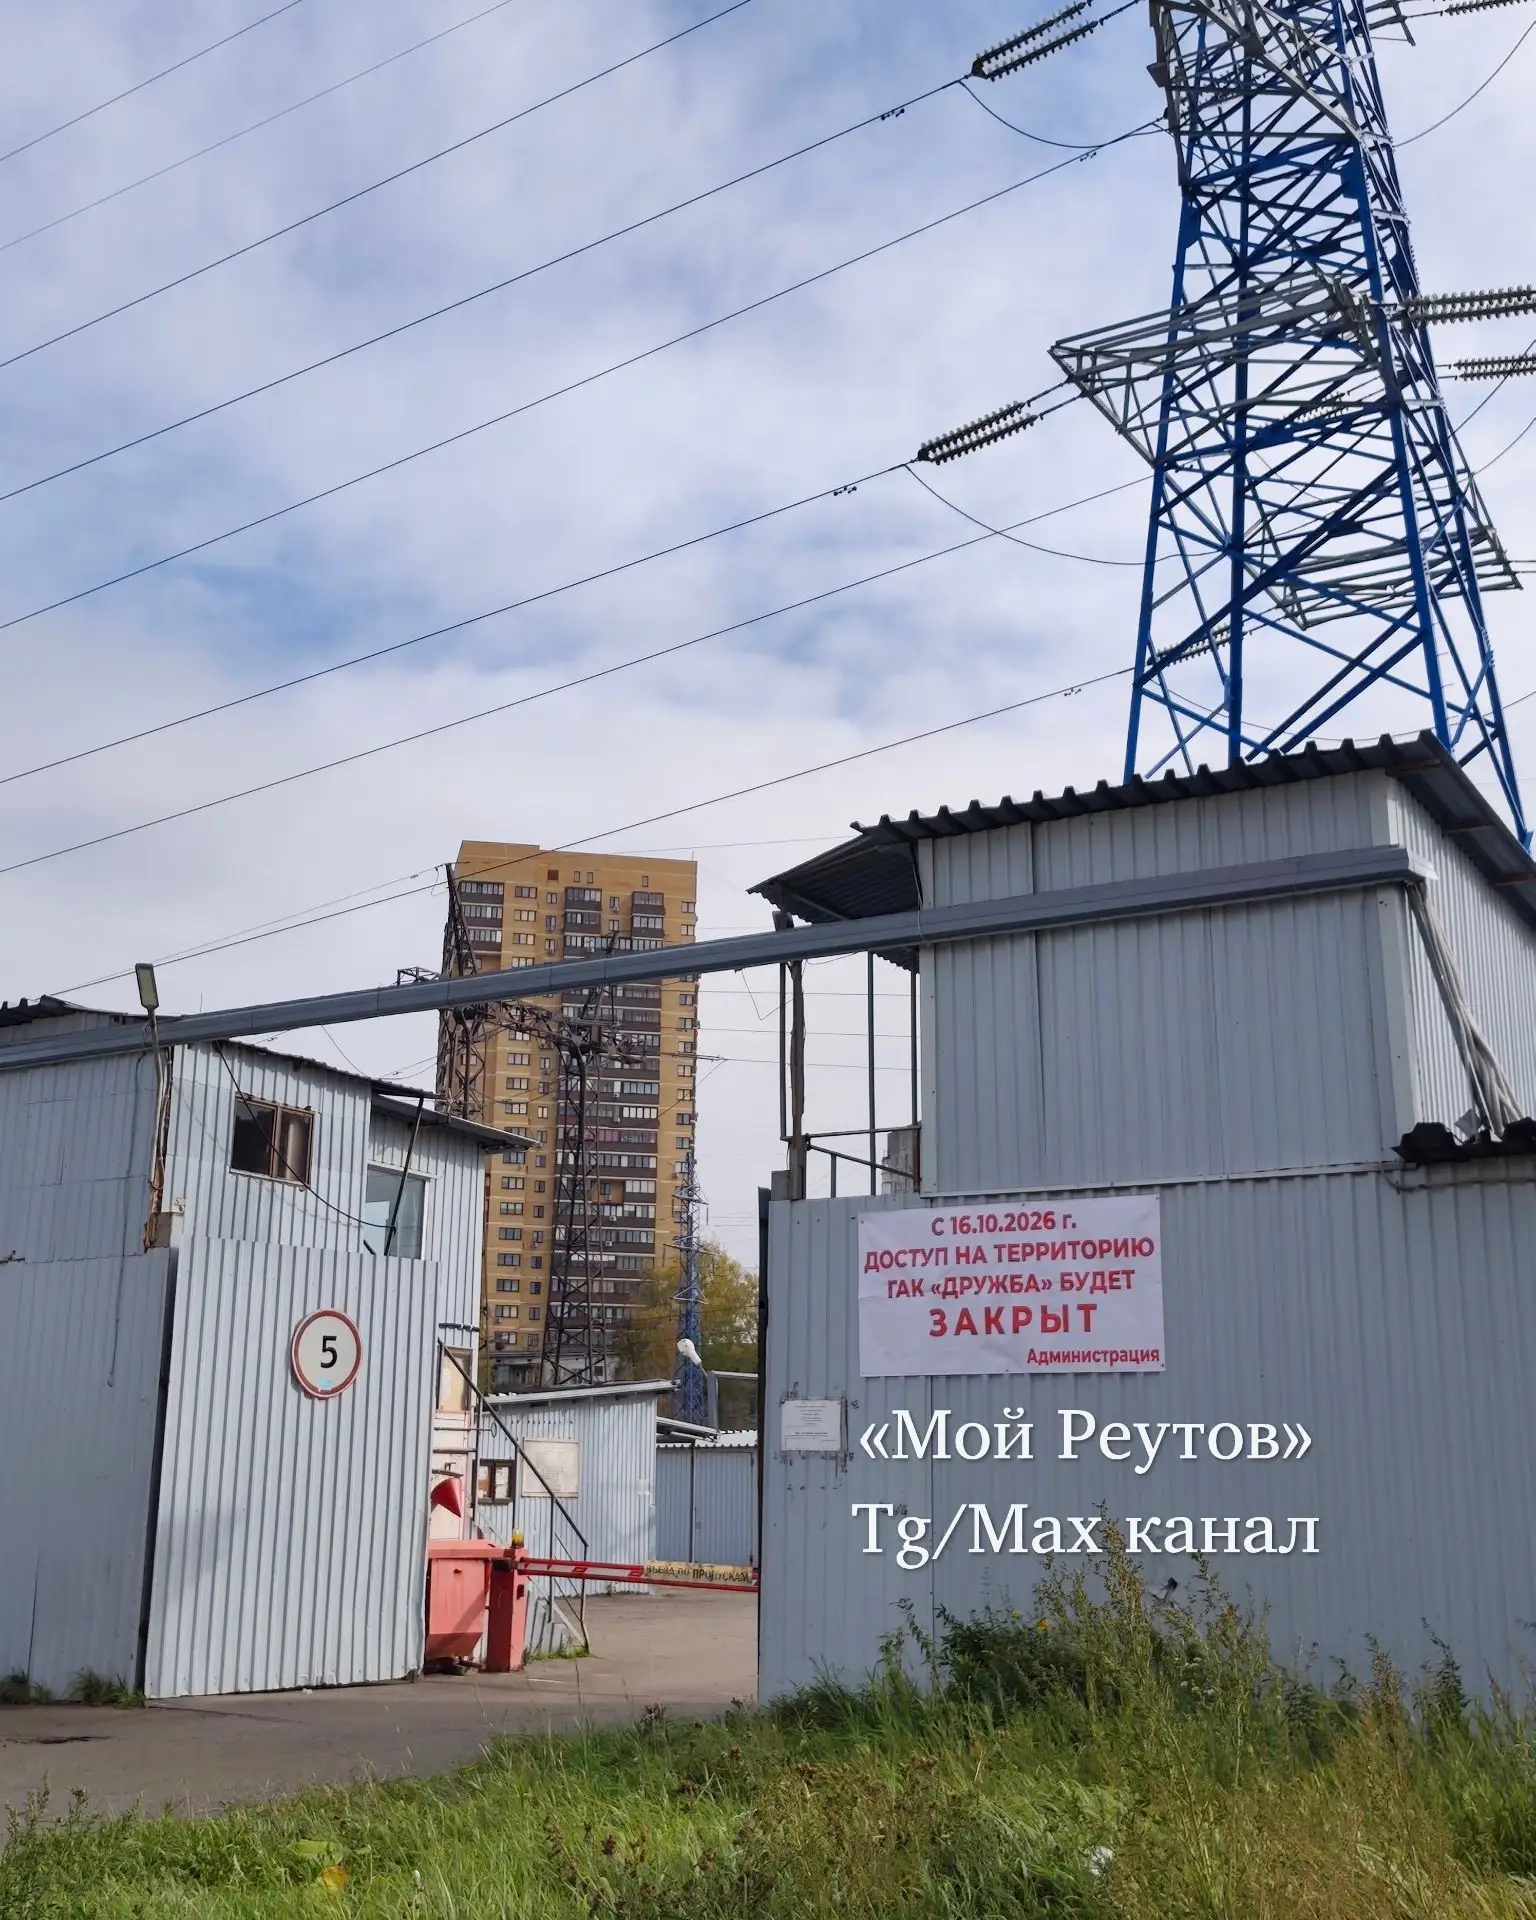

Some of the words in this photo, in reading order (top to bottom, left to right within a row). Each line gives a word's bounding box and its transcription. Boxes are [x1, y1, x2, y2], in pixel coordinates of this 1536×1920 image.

[951, 1210, 1056, 1235] 16.10.2026
[1062, 1213, 1078, 1230] г.
[864, 1247, 947, 1273] ДОСТУП
[955, 1246, 988, 1265] НА
[994, 1236, 1155, 1263] ТЕРРИТОРИЮ
[888, 1278, 925, 1299] ГАК
[931, 1273, 1053, 1299] «ДРУЖБА»
[1060, 1269, 1135, 1295] БУДЕТ
[929, 1303, 1099, 1337] ЗАКРЫТ
[320, 1335, 338, 1369] 5
[1027, 1348, 1161, 1366] Администрация
